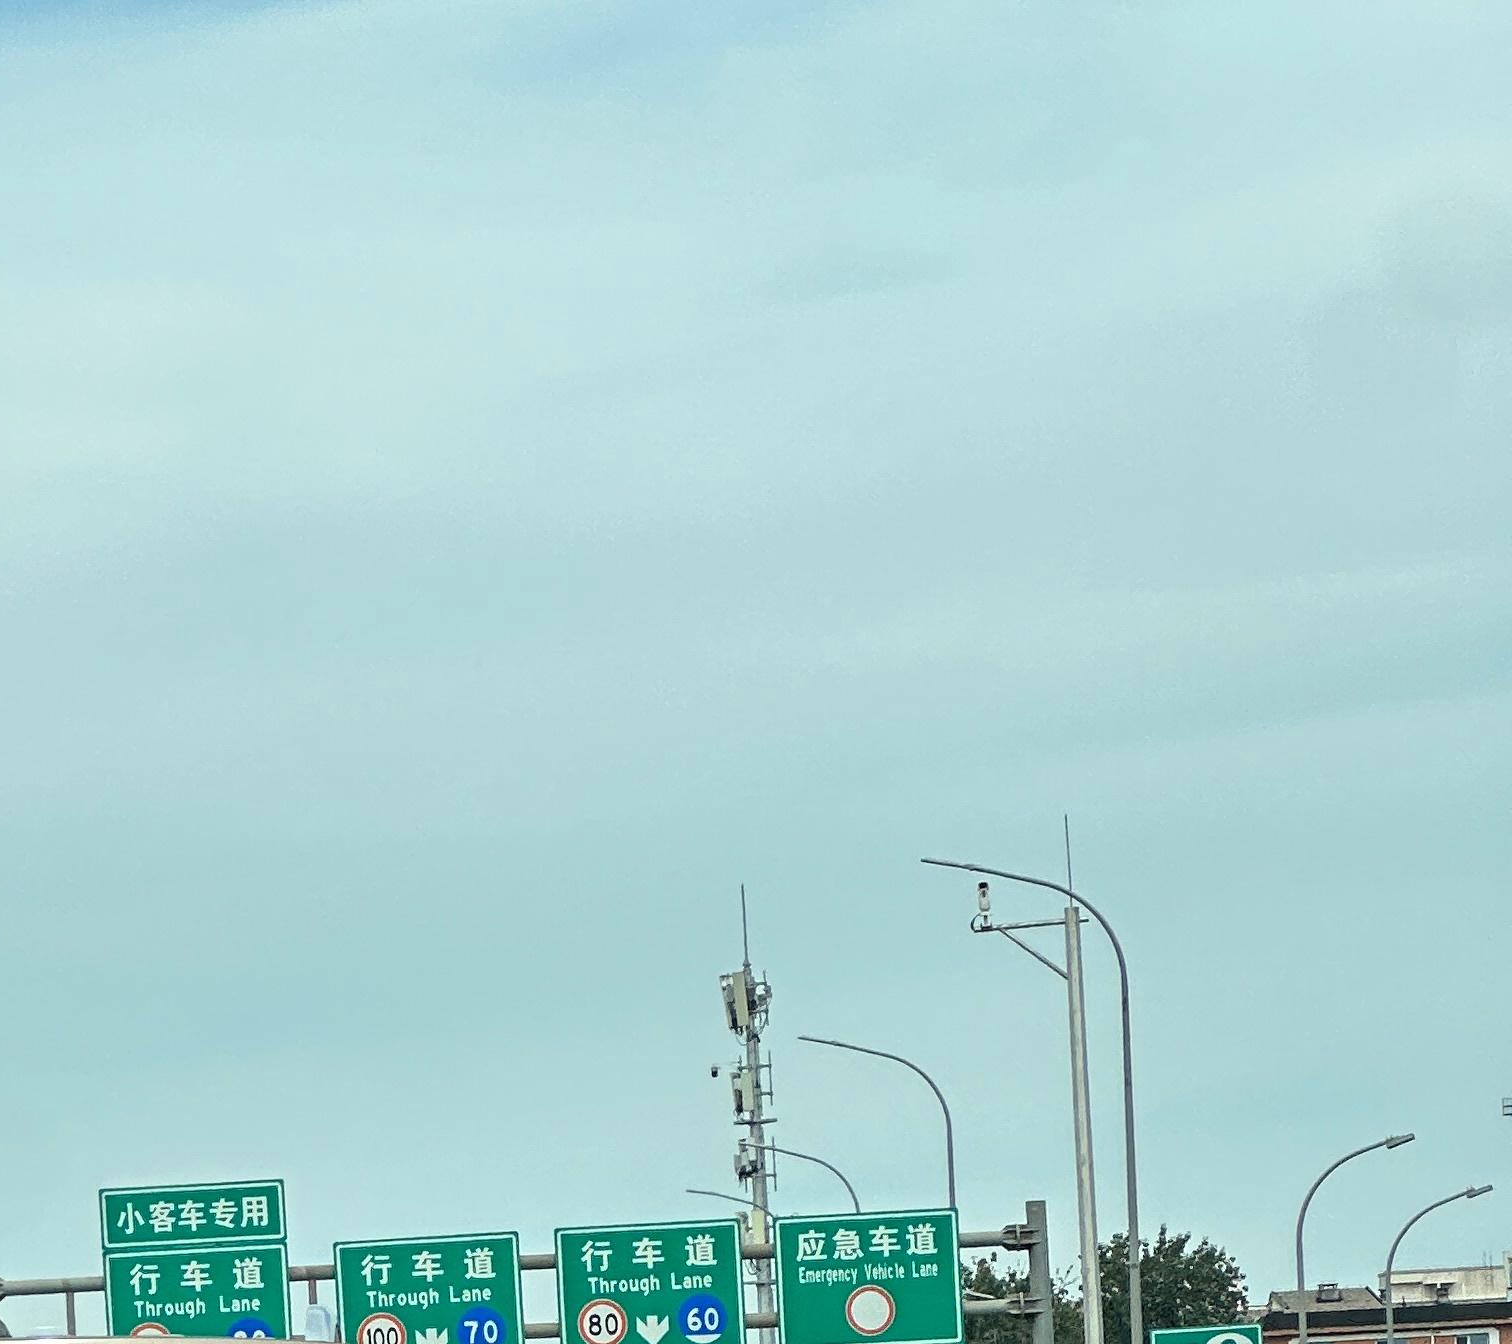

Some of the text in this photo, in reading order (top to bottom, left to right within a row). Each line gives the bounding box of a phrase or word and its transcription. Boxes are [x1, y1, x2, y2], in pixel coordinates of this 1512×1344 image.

[117, 1196, 269, 1234] 小客车专用
[581, 1234, 718, 1272] 行车道
[796, 1223, 939, 1262] 应急车道
[130, 1257, 265, 1296] 行车道
[361, 1247, 497, 1286] 行车道
[798, 1261, 939, 1287] Emergency Vehicle Lane
[588, 1272, 713, 1296] Through Lane
[134, 1296, 261, 1319] Through Lane
[366, 1286, 492, 1310] Through Lane
[463, 1320, 498, 1344] 70
[588, 1312, 620, 1337] 80
[686, 1307, 720, 1332] 60
